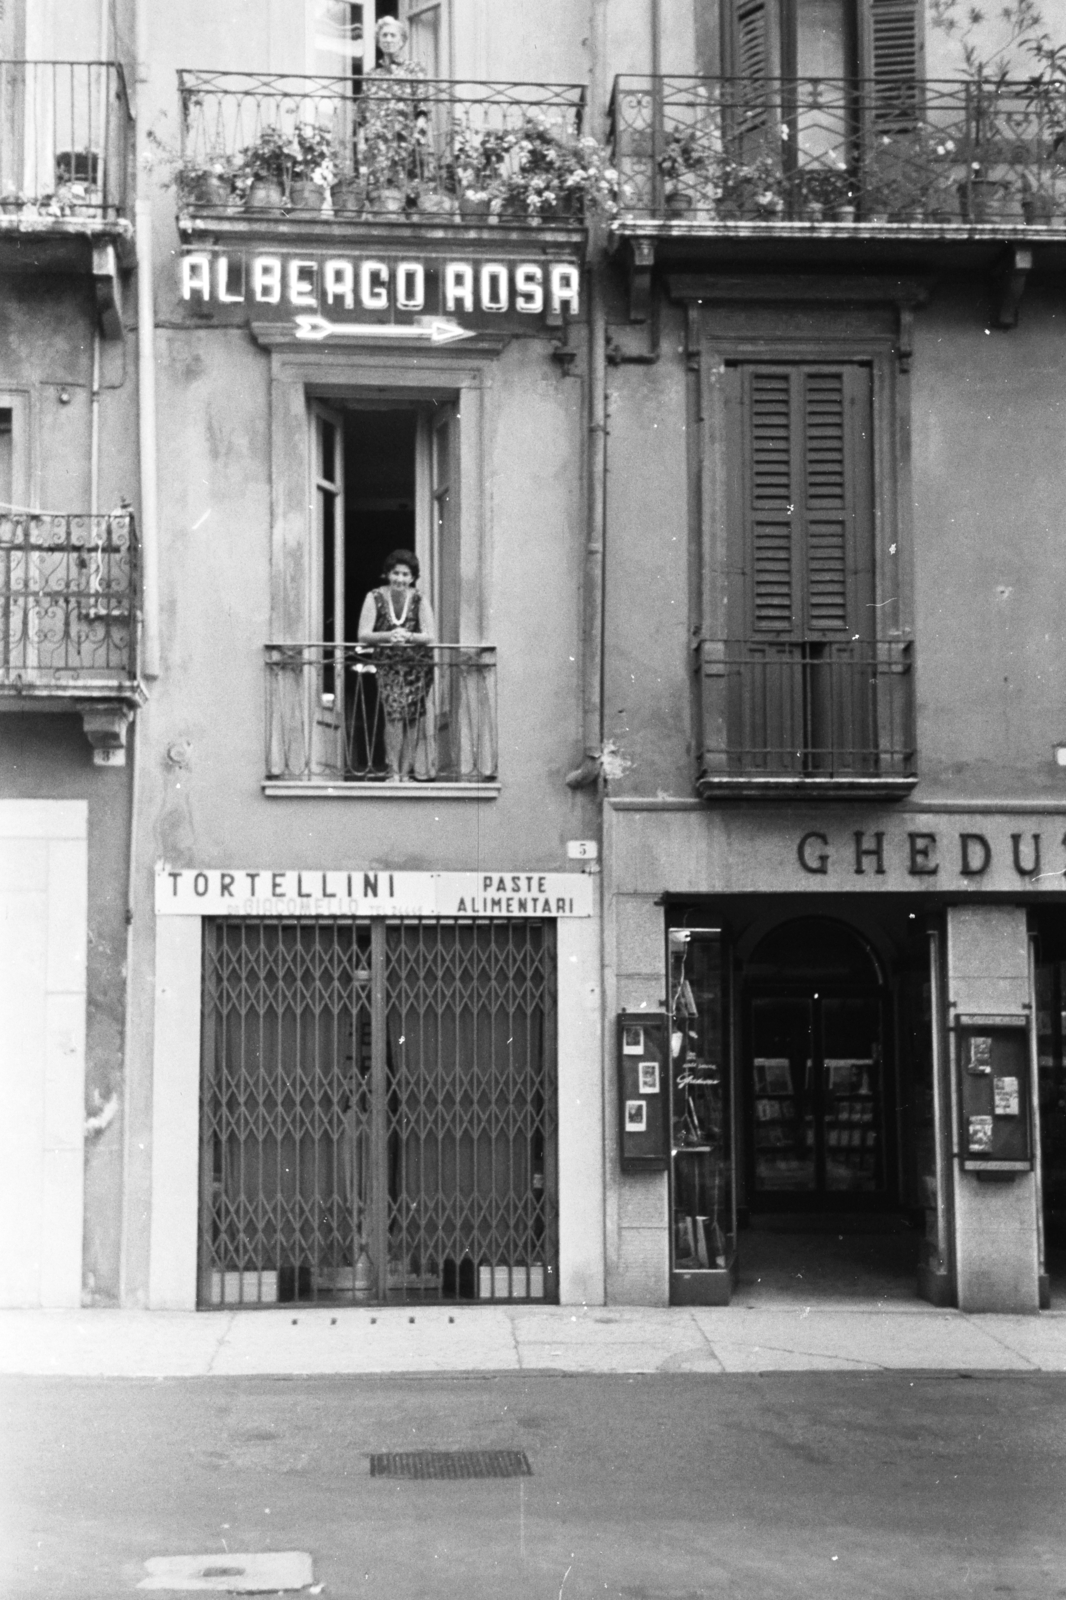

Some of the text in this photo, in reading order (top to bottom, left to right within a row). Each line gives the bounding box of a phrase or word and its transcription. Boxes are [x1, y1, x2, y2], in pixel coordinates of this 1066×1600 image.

[182, 255, 580, 315] ALBERGO ROSA
[797, 829, 1066, 876] GHEDU
[168, 871, 395, 898] TORTELLINI
[483, 875, 547, 893] PASTE
[244, 897, 358, 915] GIACOMELLO
[456, 896, 574, 914] ALIMENTARI
